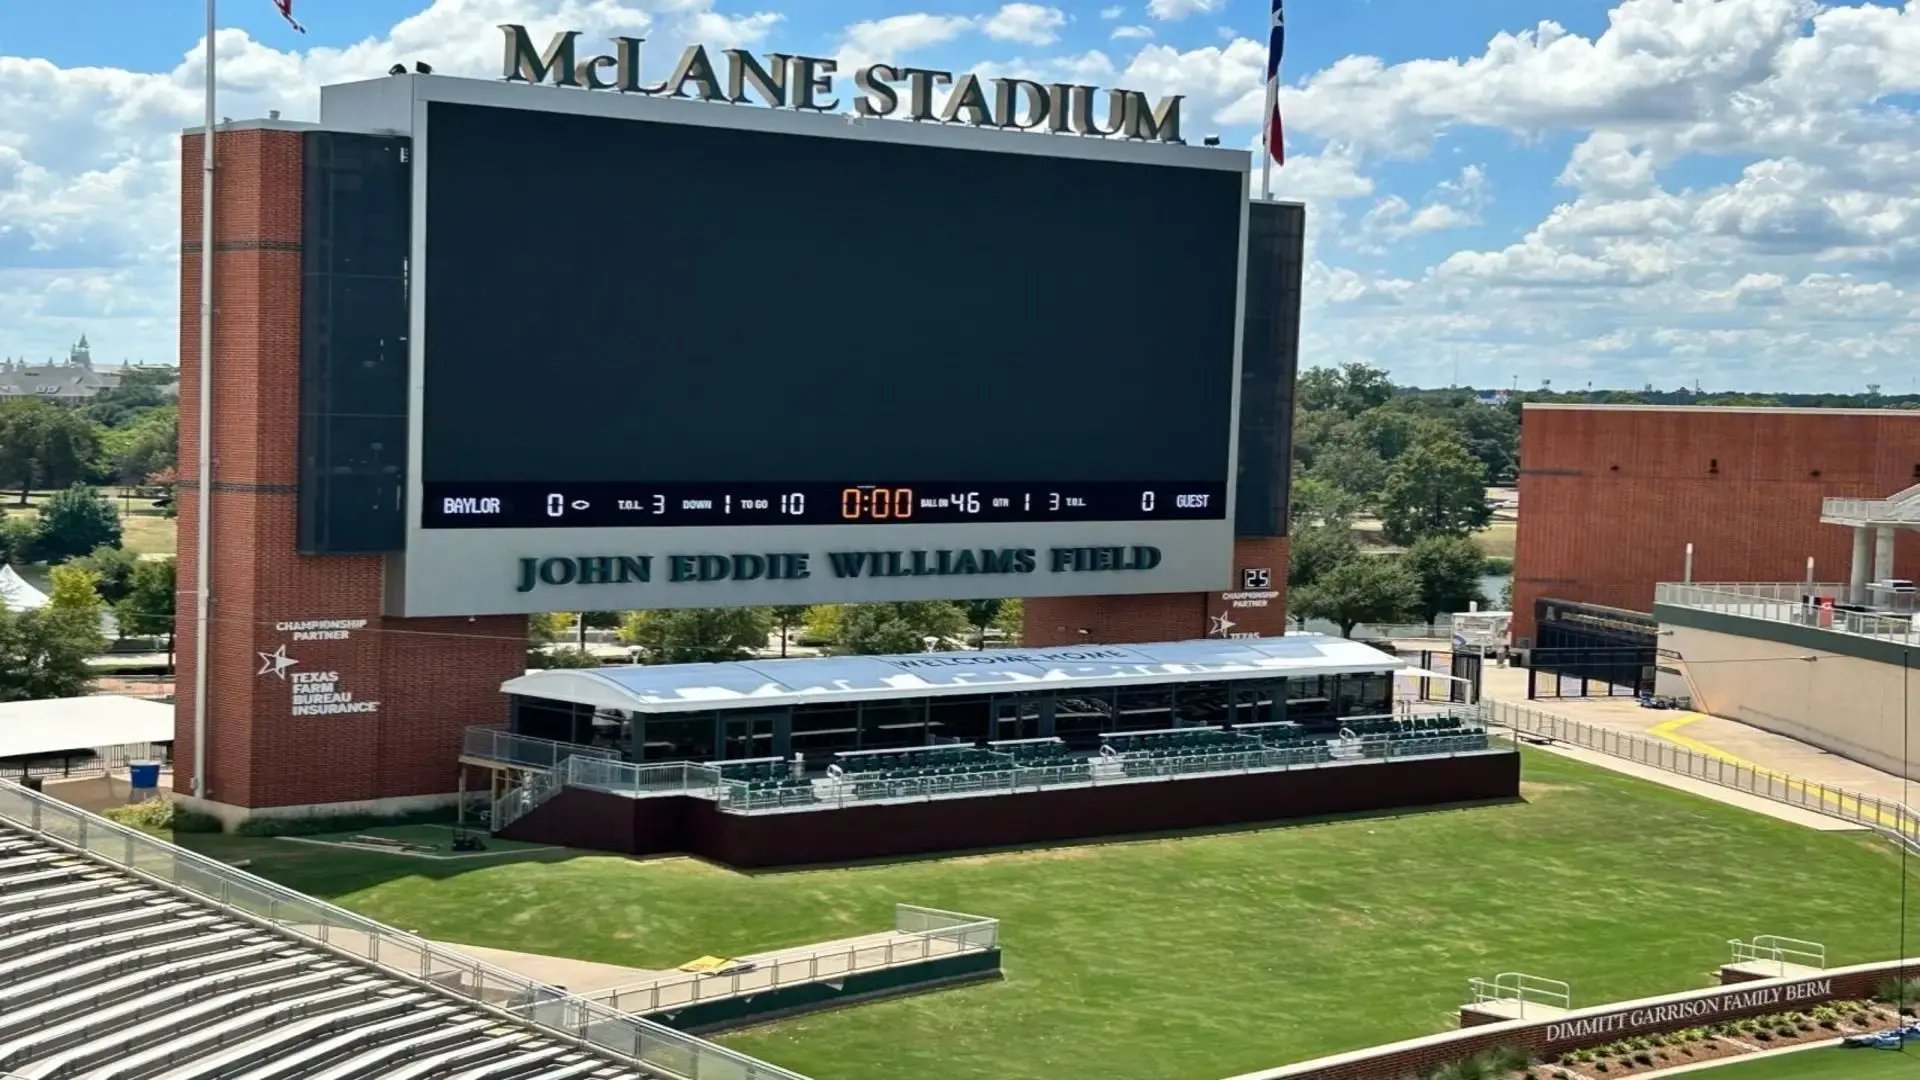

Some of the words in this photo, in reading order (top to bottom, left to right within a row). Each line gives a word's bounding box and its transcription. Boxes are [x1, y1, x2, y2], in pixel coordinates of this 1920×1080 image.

[496, 23, 840, 112] McLANE
[853, 63, 1187, 145] STADIUM
[443, 497, 501, 514] BAYLOR
[546, 493, 564, 517] 0
[652, 494, 666, 514] 3
[682, 500, 713, 510] DOWN
[724, 494, 731, 514] 1
[740, 499, 754, 509] TO
[755, 499, 769, 509] GO
[781, 493, 805, 515] 10
[842, 488, 913, 518] 0:00
[920, 498, 938, 508] BALL
[951, 492, 981, 514] 46
[992, 497, 1009, 507] QTR
[1024, 493, 1031, 512] 1
[1048, 493, 1060, 511] 3
[1141, 491, 1155, 512] 0
[1176, 494, 1211, 508] GUEST
[517, 555, 655, 592] JOHN
[668, 552, 810, 583] EDDIE
[828, 548, 1036, 579] WILLIAMS
[1050, 545, 1163, 573] FIELD
[1247, 570, 1269, 587] 25
[1222, 591, 1279, 601] CHAMPIONSHIP
[1233, 600, 1269, 608] PARTNER
[276, 619, 368, 631] CHAMPIONSHIP
[293, 630, 350, 641] PARTNER
[898, 651, 1036, 668] WELCOME
[1041, 649, 1128, 663] HOME
[291, 671, 339, 683] TEXAS
[292, 682, 334, 694] FARM
[292, 692, 352, 705] BUREAU
[292, 701, 379, 716] INSURANCE
[1546, 1012, 1628, 1042] DIMMITT
[1631, 997, 1719, 1026] GARRISON
[1723, 986, 1781, 1011] FAMILY
[1786, 979, 1832, 1000] BERM
